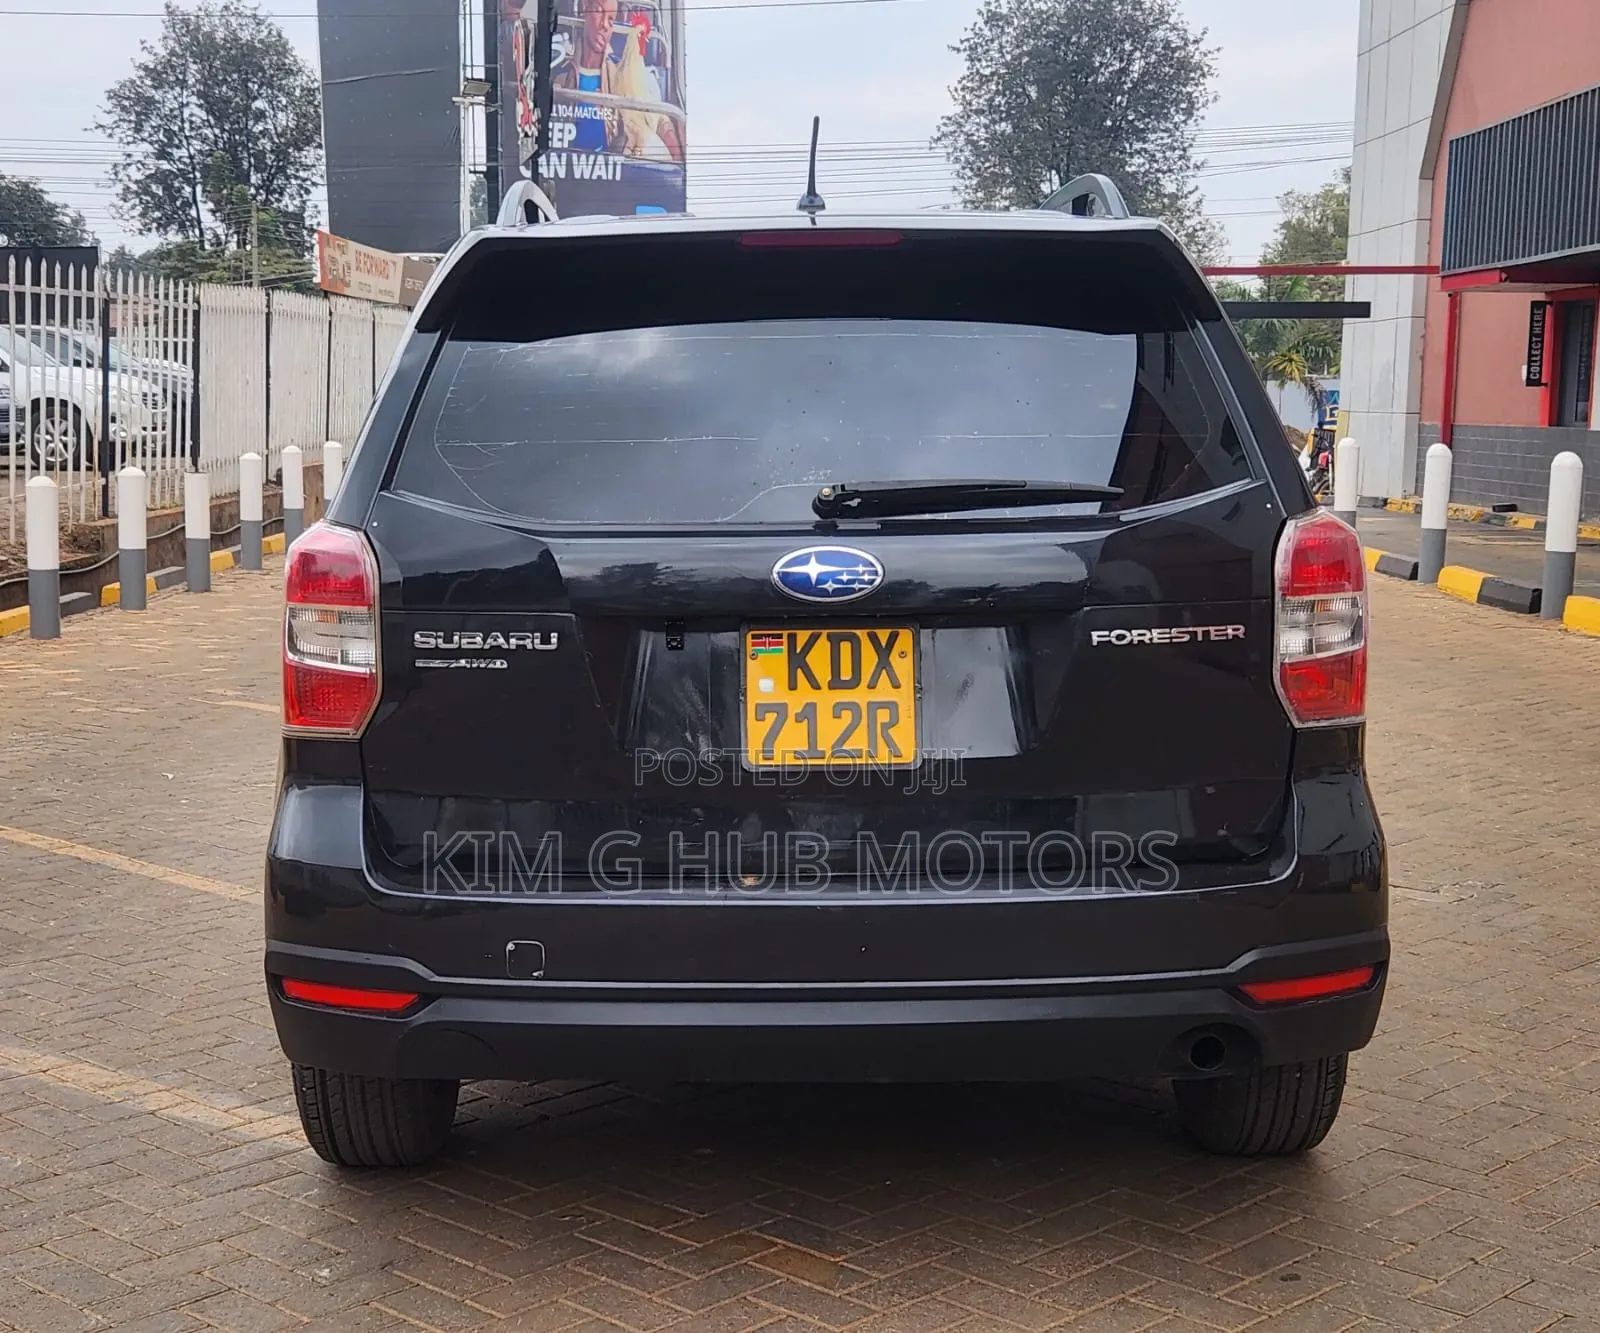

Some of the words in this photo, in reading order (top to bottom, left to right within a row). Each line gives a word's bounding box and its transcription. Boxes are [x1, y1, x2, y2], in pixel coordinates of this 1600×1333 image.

[574, 105, 614, 121] MATCHES
[548, 121, 577, 149] EP
[572, 153, 625, 181] WAIT
[1533, 307, 1544, 334] HERE
[1529, 336, 1542, 380] COLLECT
[413, 630, 559, 651] SUBARU
[1090, 624, 1246, 647] FORESTER
[786, 630, 902, 691] KDX
[754, 700, 903, 760] 712R
